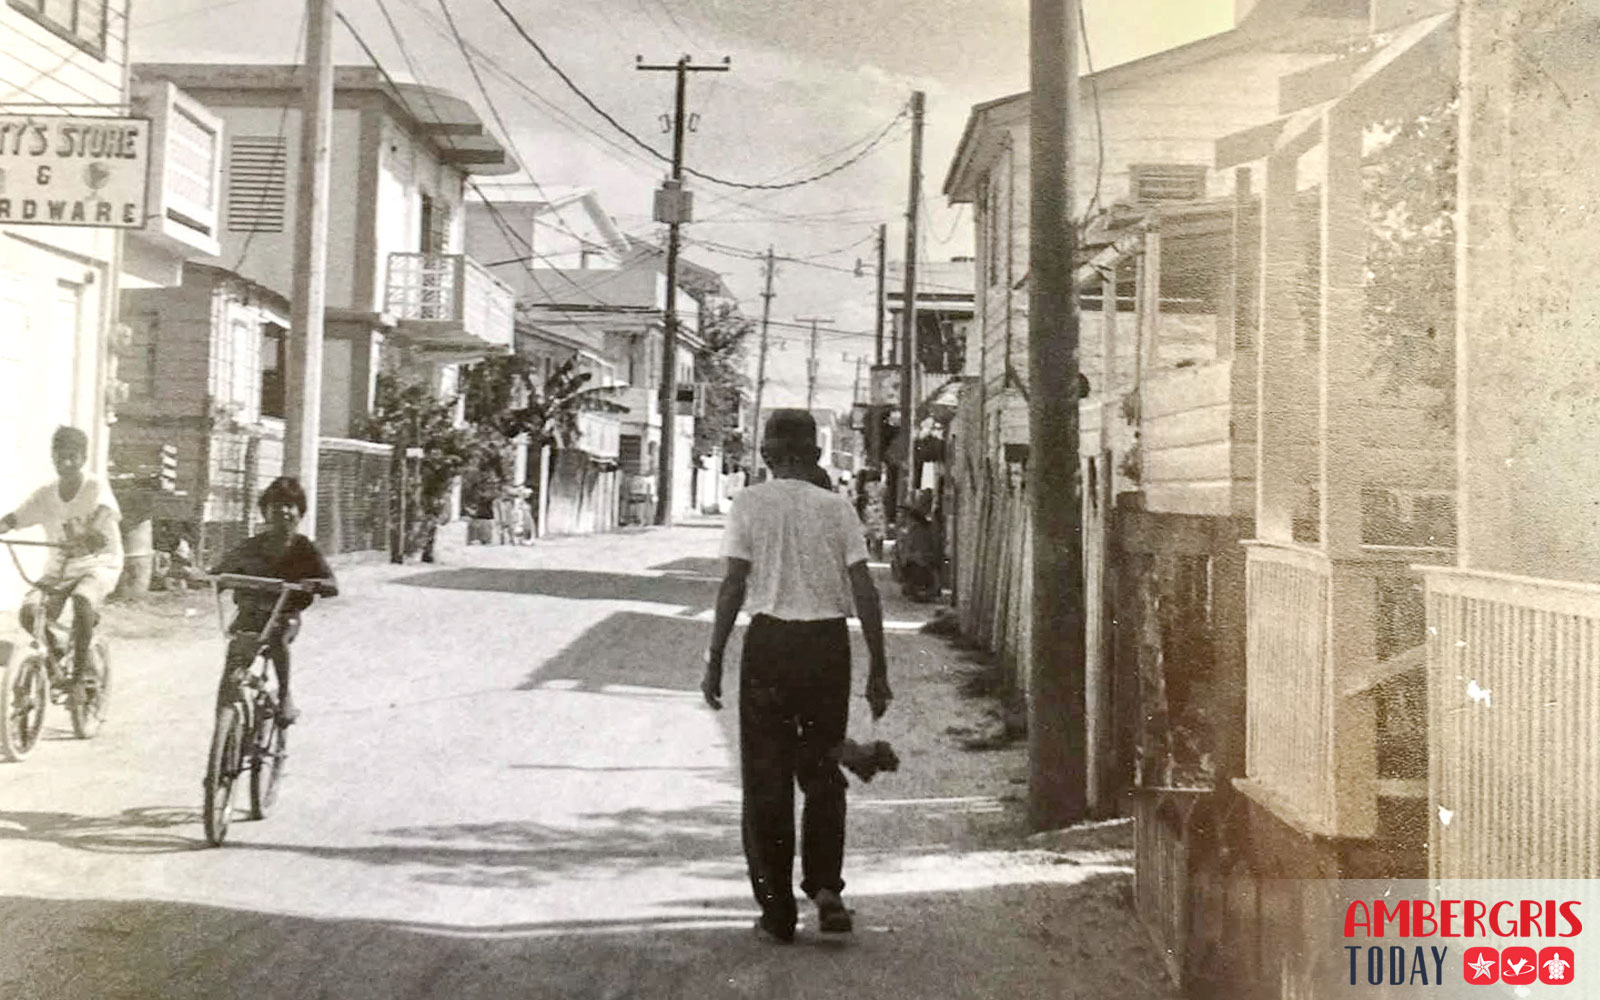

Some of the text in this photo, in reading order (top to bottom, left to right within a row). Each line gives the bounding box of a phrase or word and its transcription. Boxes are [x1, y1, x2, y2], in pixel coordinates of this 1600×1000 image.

[57, 122, 138, 159] STORE
[37, 165, 52, 186] &
[0, 199, 136, 223] RDWARE
